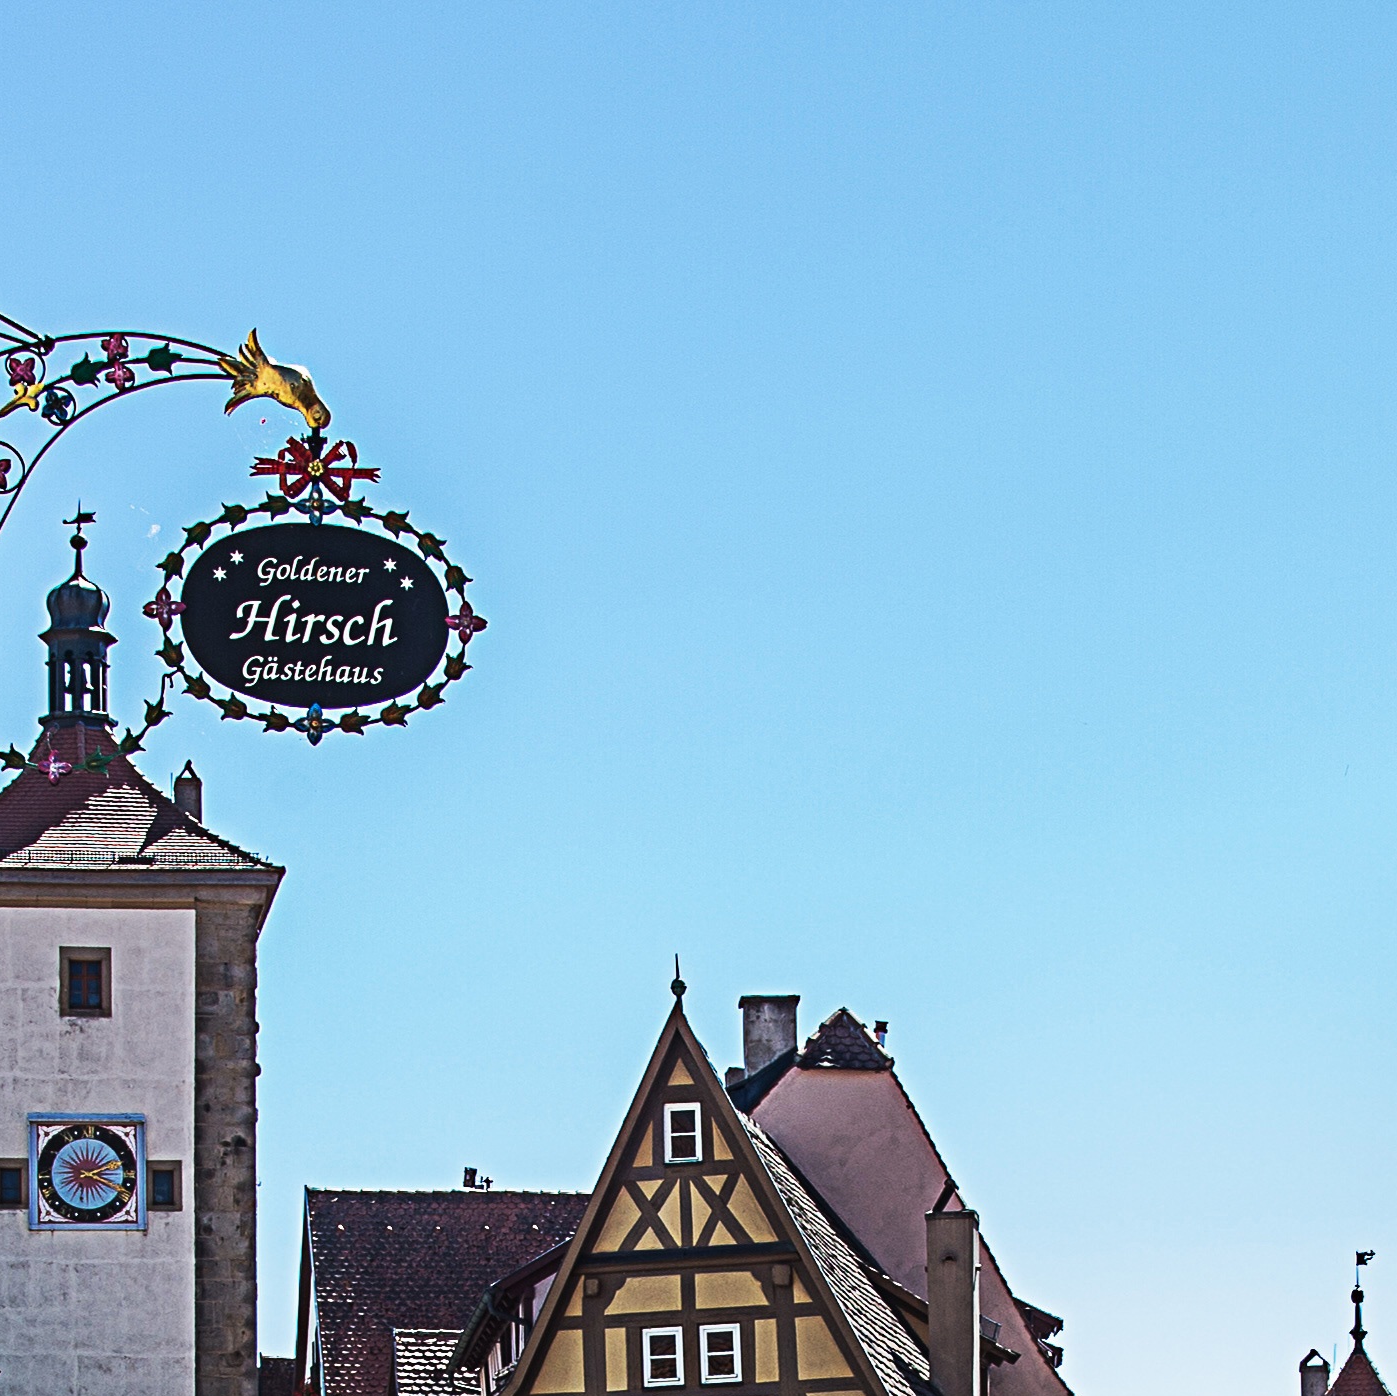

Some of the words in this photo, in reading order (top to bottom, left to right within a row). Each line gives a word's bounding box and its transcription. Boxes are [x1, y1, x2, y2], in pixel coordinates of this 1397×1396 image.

[256, 555, 370, 586] Goldener
[228, 594, 398, 647] Hirsch
[241, 654, 384, 687] Gästehaus
